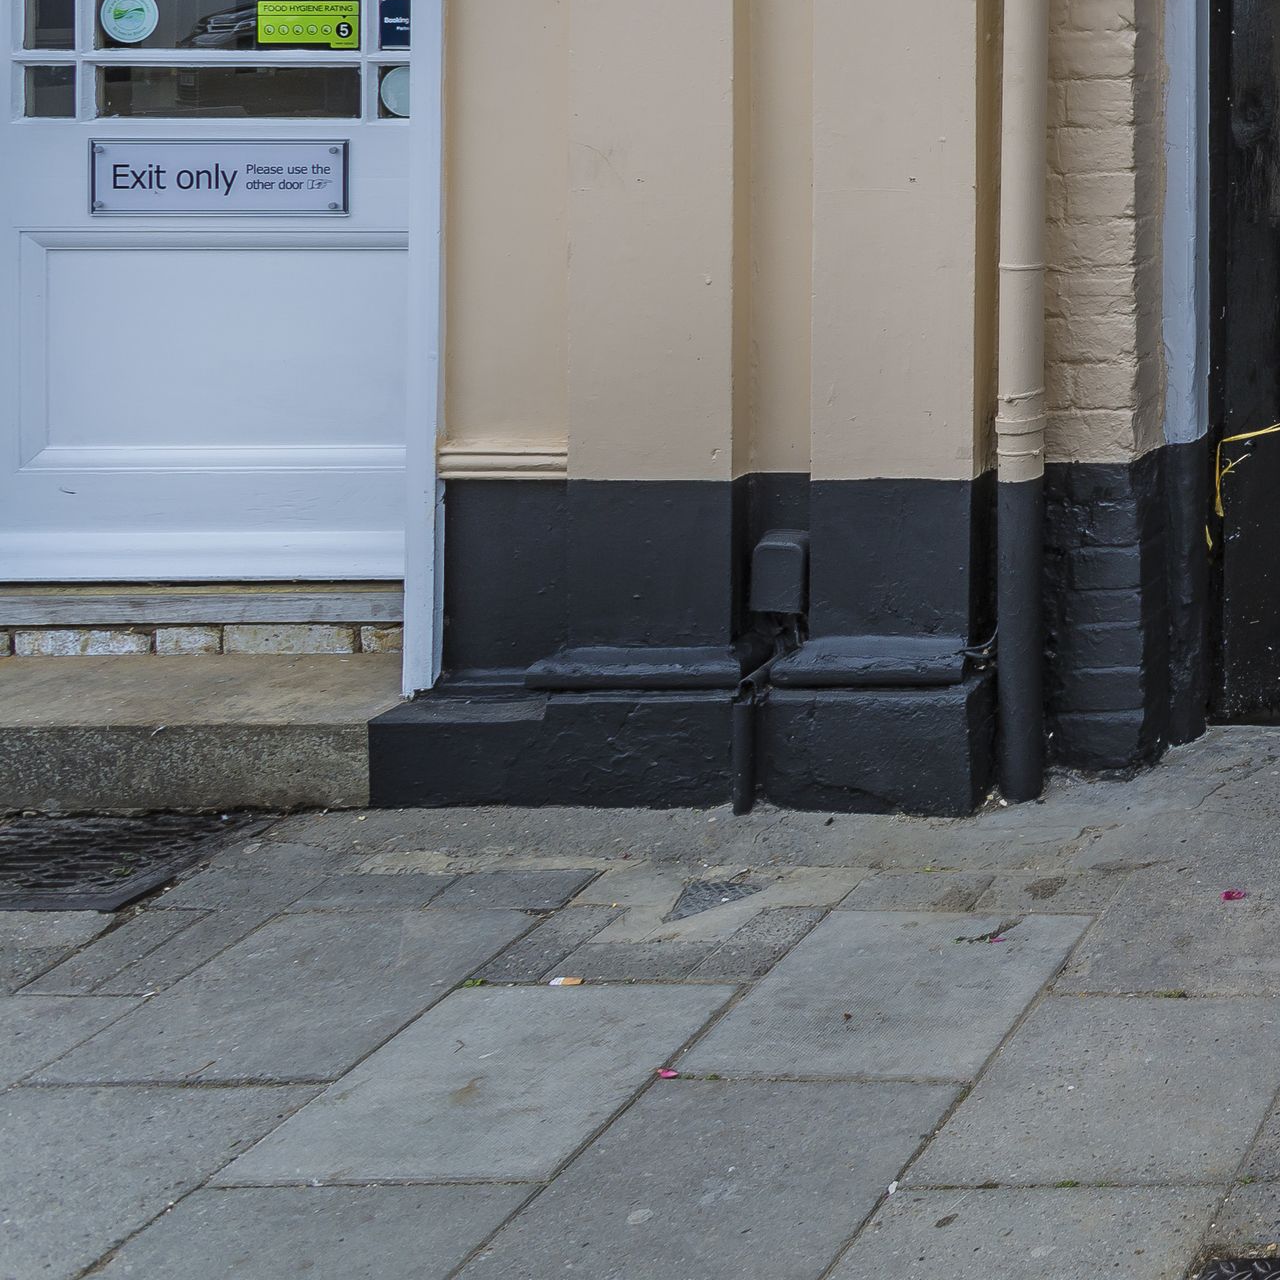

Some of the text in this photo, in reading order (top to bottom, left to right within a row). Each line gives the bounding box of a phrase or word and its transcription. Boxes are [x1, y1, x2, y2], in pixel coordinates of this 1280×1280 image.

[263, 4, 353, 12] FOOD HYGIENE RATING
[339, 24, 349, 37] 5
[246, 163, 331, 175] Please use the
[112, 162, 238, 196] Exit only
[246, 179, 305, 190] other door
